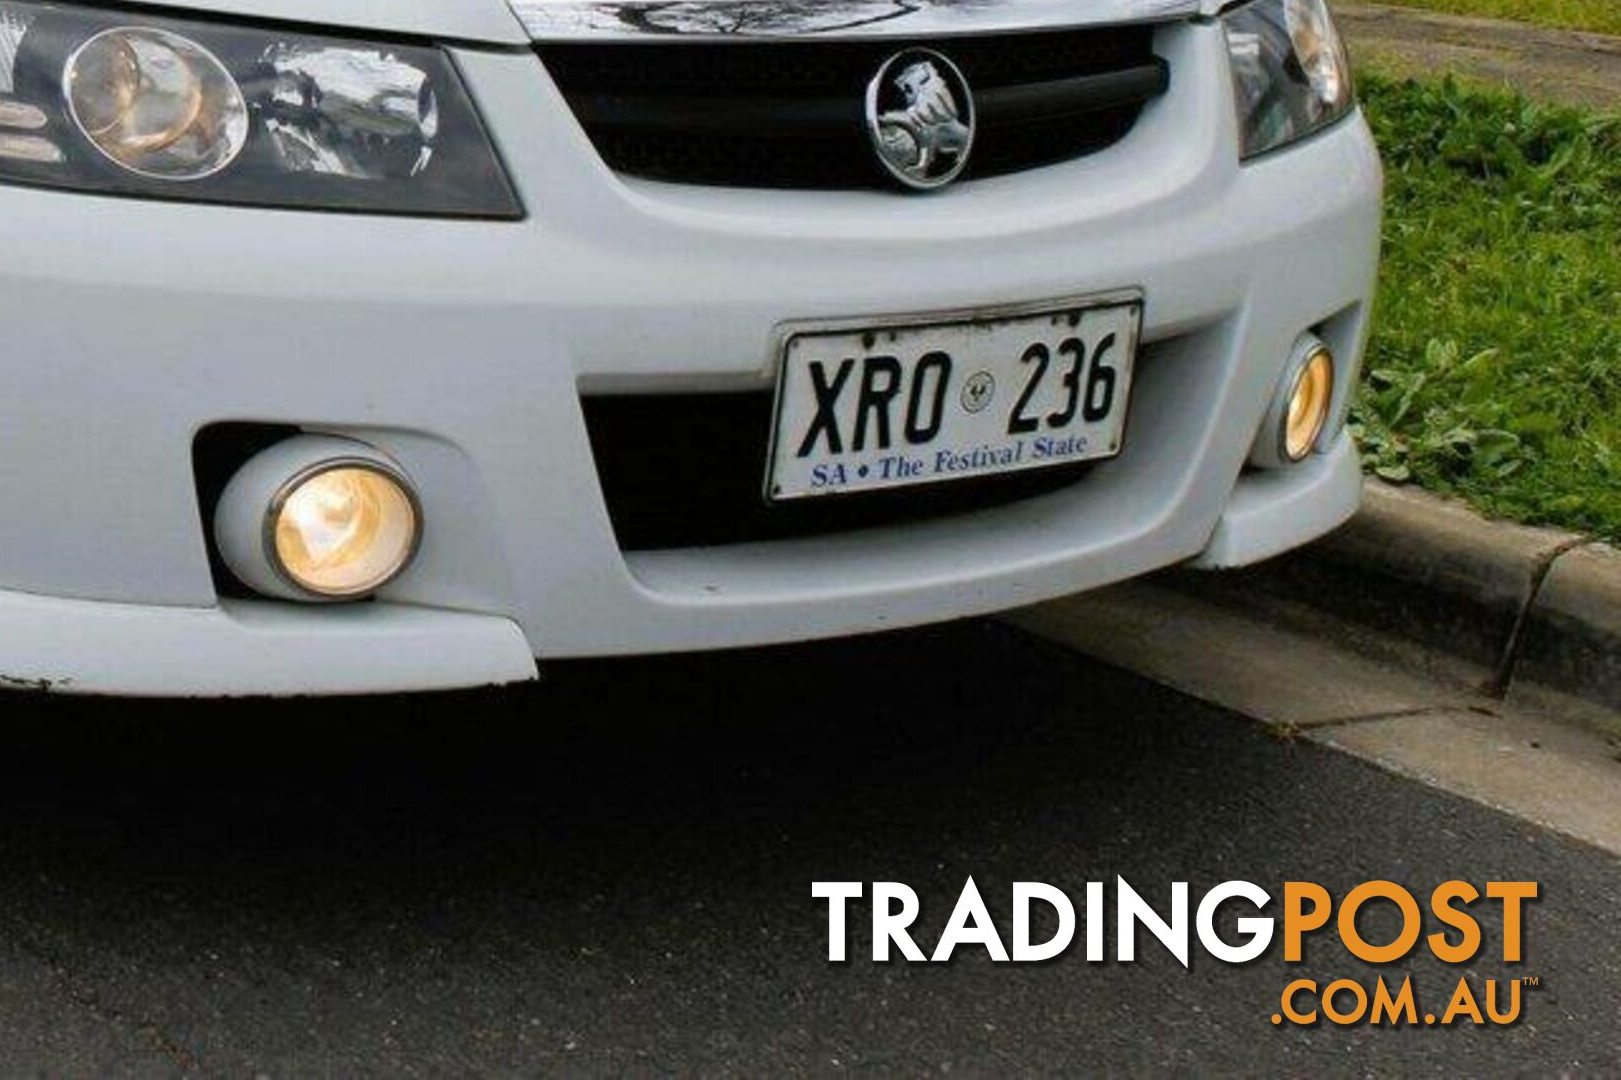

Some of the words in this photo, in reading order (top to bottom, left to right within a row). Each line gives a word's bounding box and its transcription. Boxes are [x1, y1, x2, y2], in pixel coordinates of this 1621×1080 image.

[797, 350, 952, 458] XRO
[1007, 332, 1116, 435] 236
[811, 463, 847, 488] SA
[879, 455, 923, 479] The
[934, 440, 1024, 473] Festival
[1032, 433, 1088, 459] State
